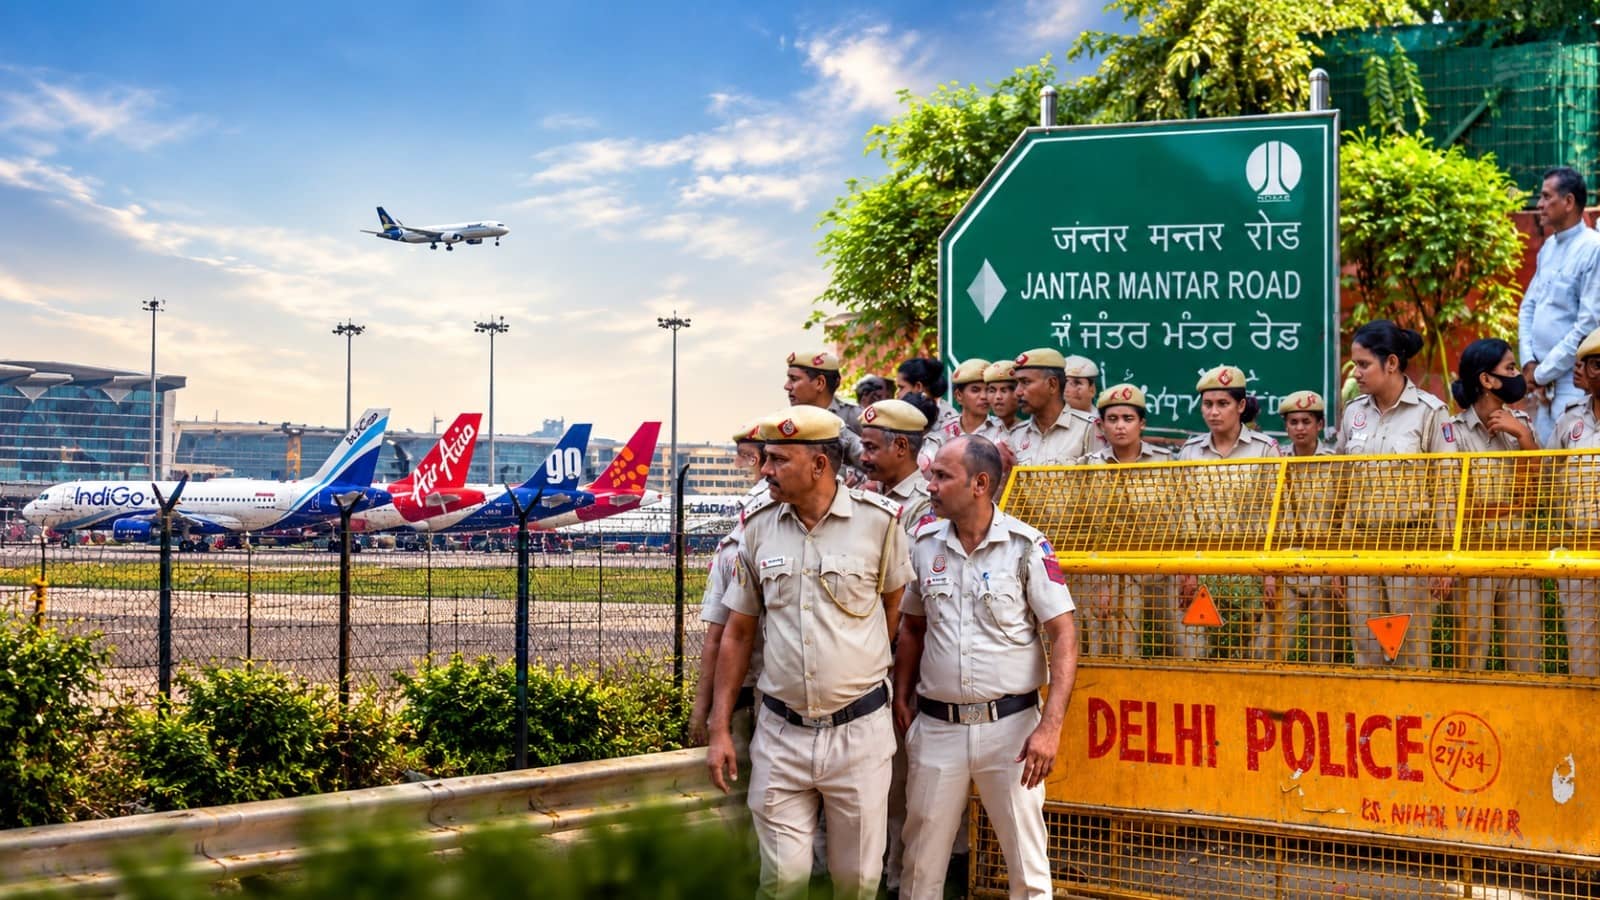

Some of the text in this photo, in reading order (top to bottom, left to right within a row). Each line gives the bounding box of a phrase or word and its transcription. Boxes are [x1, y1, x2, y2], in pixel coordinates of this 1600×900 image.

[1148, 223, 1224, 252] मन्तर
[1245, 210, 1302, 251] रोड
[1020, 270, 1301, 300] JANTAR MANTAR ROAD
[1080, 311, 1151, 349] ਜੰਤਰ
[1162, 311, 1236, 349] ਮੰਤਰ
[1249, 310, 1302, 350] ਰੋਡ
[74, 485, 144, 506] IndiGo
[1088, 697, 1424, 782] DELHI POLICE
